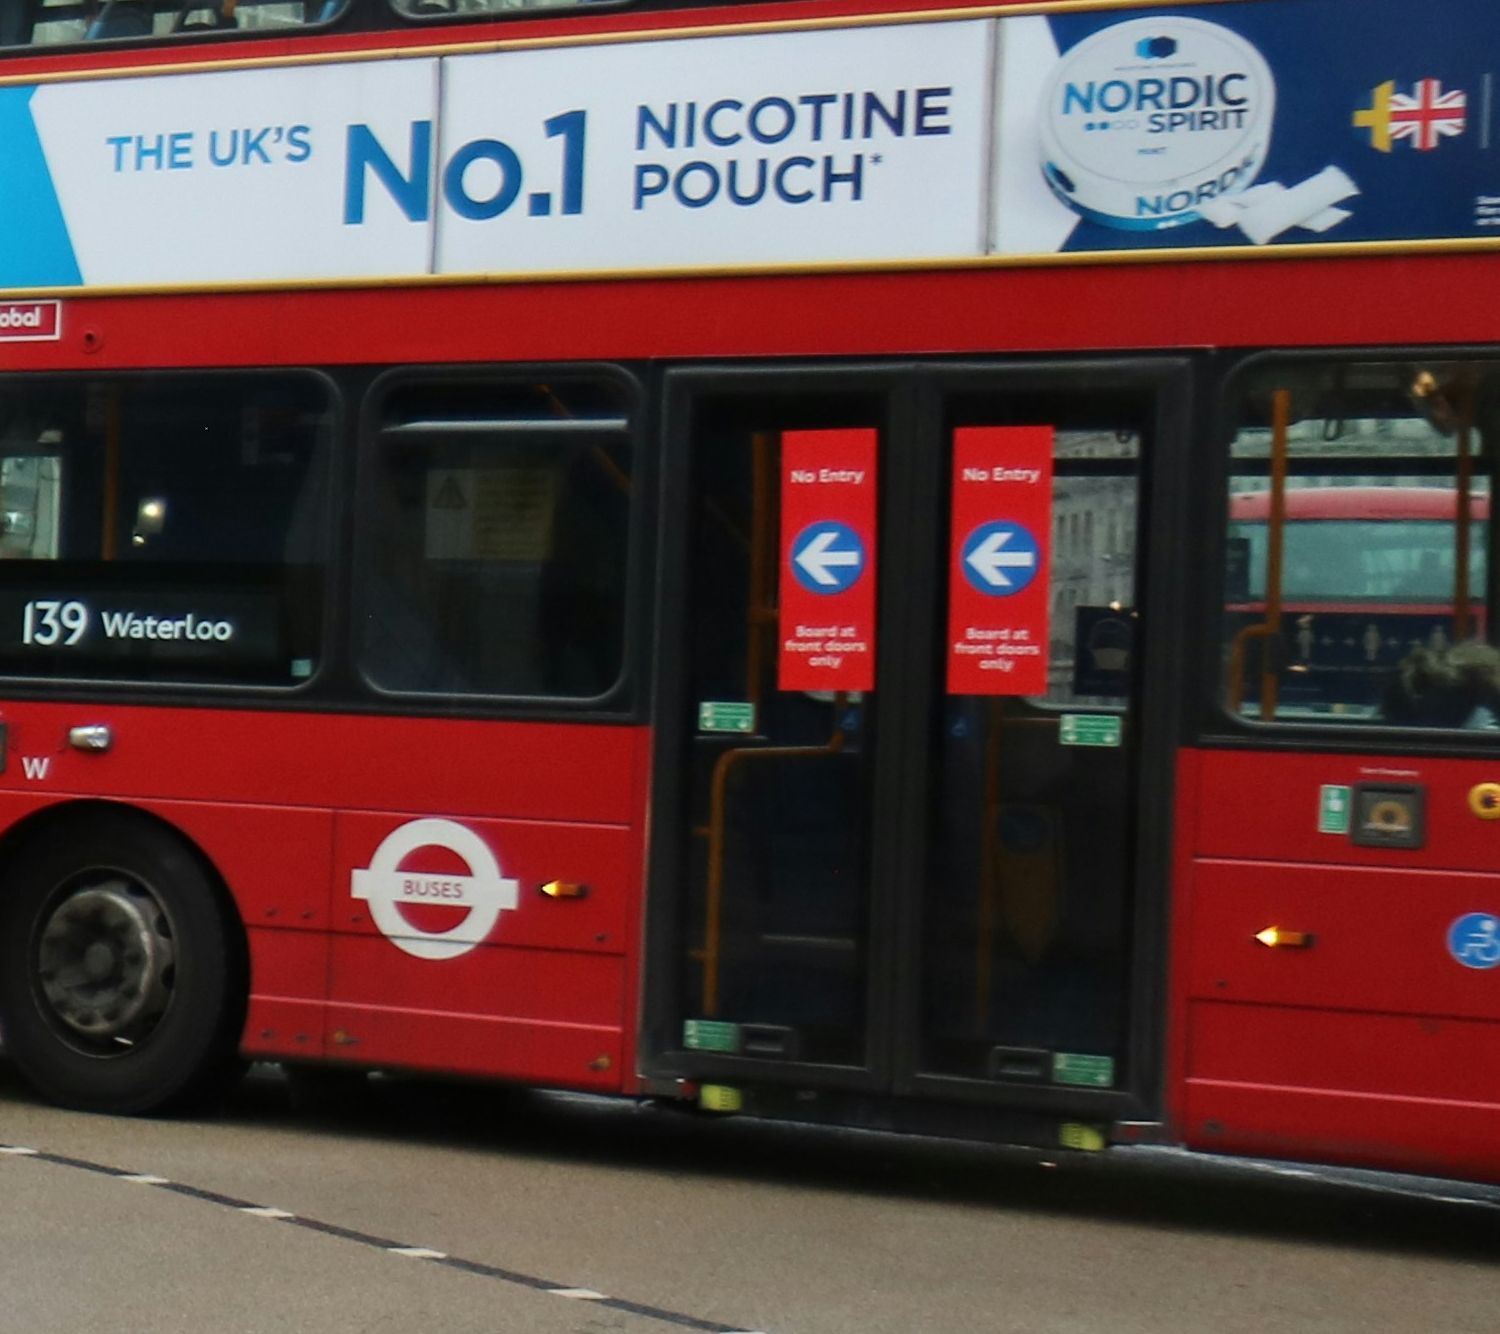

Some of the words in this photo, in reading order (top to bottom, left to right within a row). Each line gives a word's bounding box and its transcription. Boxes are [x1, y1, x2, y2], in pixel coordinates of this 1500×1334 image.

[1062, 73, 1249, 115] NORDIC
[635, 86, 954, 151] NICOTINE
[1147, 108, 1249, 134] SPIRIT
[106, 132, 194, 172] THE
[208, 125, 312, 167] UK'S
[342, 109, 588, 225] No.1
[791, 470, 816, 484] No
[819, 469, 864, 485] Entry
[962, 468, 989, 482] No
[992, 467, 1041, 484] Entry
[22, 601, 88, 646] 139
[101, 611, 233, 641] Waterloo
[795, 625, 838, 638] Board
[840, 625, 856, 638] at
[966, 627, 1009, 640] Board
[1012, 628, 1029, 640] at
[785, 639, 823, 652] front
[825, 639, 867, 652] doors
[954, 642, 993, 654] front
[996, 643, 1040, 655] doors
[808, 654, 843, 668] only
[978, 657, 1014, 672] only
[21, 756, 50, 780] W
[403, 879, 464, 899] BUSES
